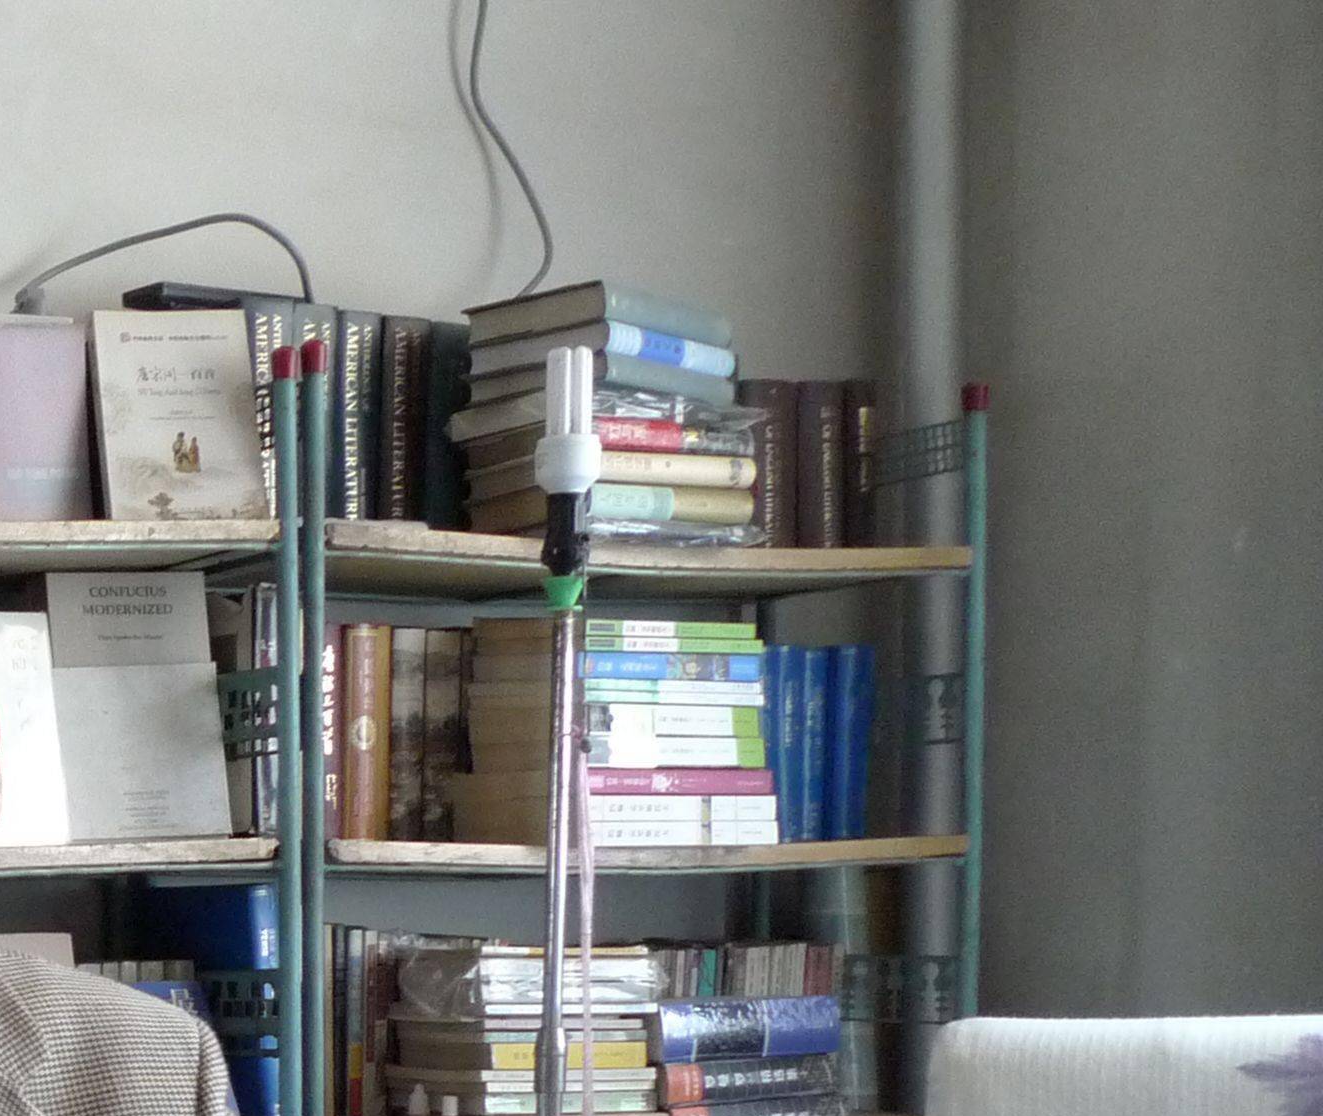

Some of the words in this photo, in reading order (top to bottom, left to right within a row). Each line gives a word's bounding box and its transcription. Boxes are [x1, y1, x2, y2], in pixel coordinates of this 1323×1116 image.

[345, 321, 360, 411] AMERICAN
[392, 326, 406, 416] AMERICAN
[391, 421, 405, 518] LITERATUR
[83, 603, 173, 616] MODERNIZED
[88, 585, 167, 598] CONFUCIUS
